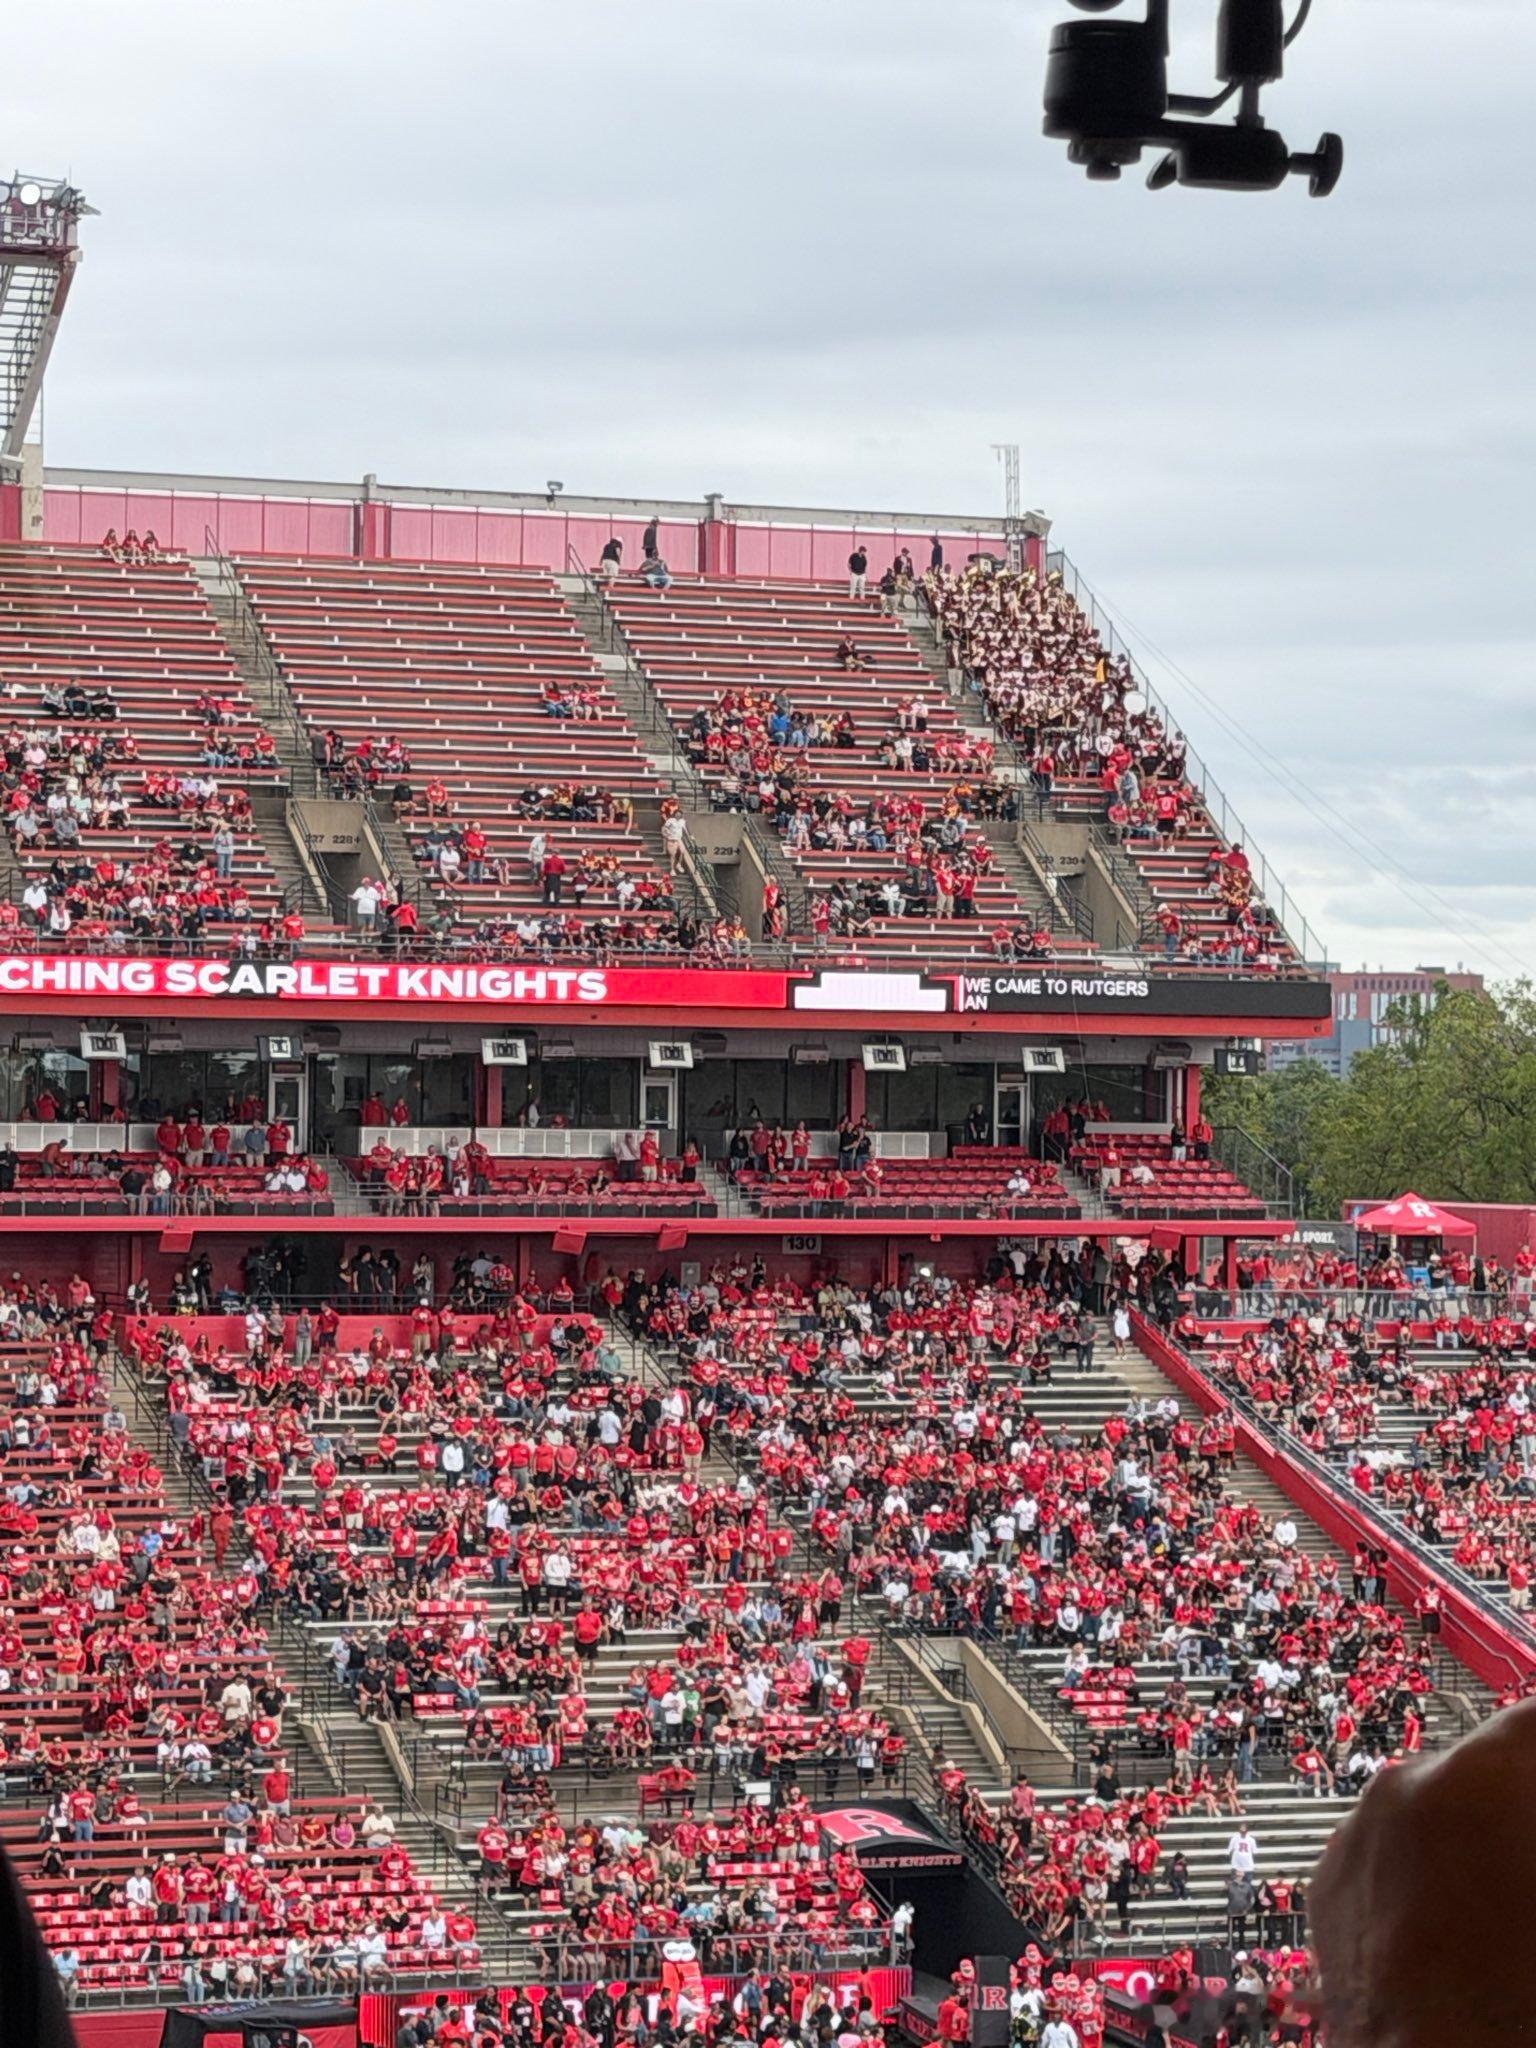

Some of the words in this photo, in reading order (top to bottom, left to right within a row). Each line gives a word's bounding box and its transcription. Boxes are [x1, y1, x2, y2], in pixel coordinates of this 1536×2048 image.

[332, 834, 353, 844] 228
[1059, 856, 1079, 865] 230
[0, 960, 154, 993] CHING
[165, 962, 389, 996] SCARLET
[397, 968, 607, 1000] KNIGHTS
[965, 978, 991, 993] WE
[994, 979, 1041, 995] CAME
[1045, 979, 1068, 995] TO
[1071, 980, 1149, 997] RUTGERS
[965, 995, 988, 1010] AN
[1408, 1202, 1436, 1218] R
[786, 1237, 817, 1250] 130
[1238, 1842, 1249, 1853] R
[981, 1985, 1008, 2011] R
